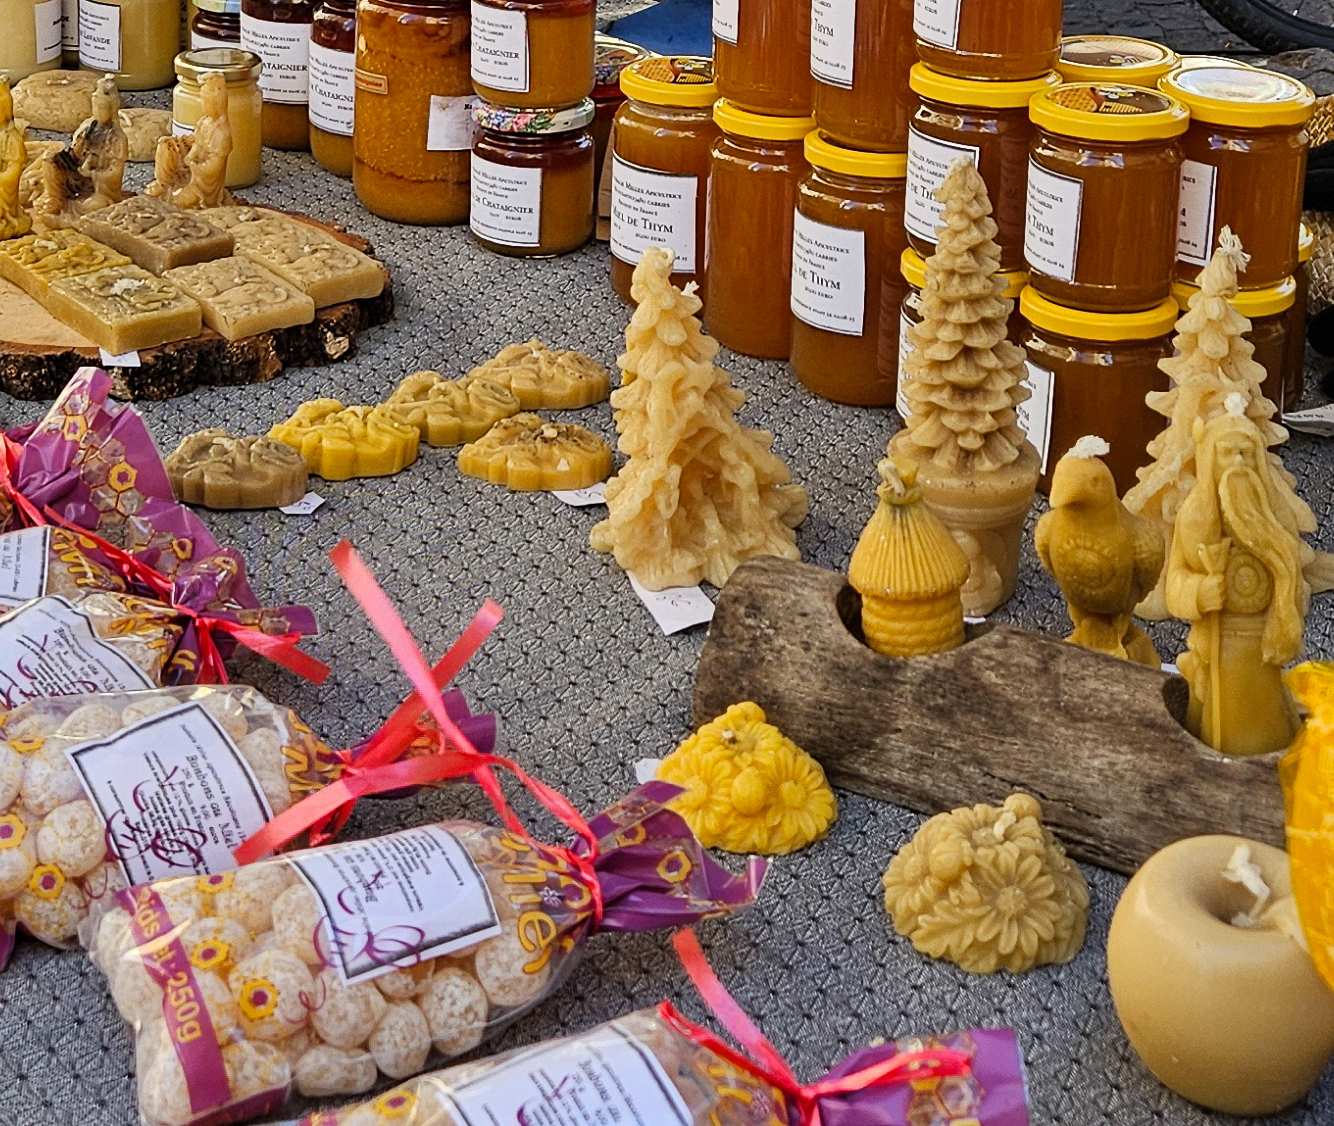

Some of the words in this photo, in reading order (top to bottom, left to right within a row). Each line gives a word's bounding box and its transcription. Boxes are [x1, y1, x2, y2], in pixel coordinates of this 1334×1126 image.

[814, 18, 834, 37] THYM
[627, 216, 638, 226] DE
[641, 217, 673, 233] THYM
[810, 270, 841, 290] THYM
[167, 971, 202, 1044] 250g
